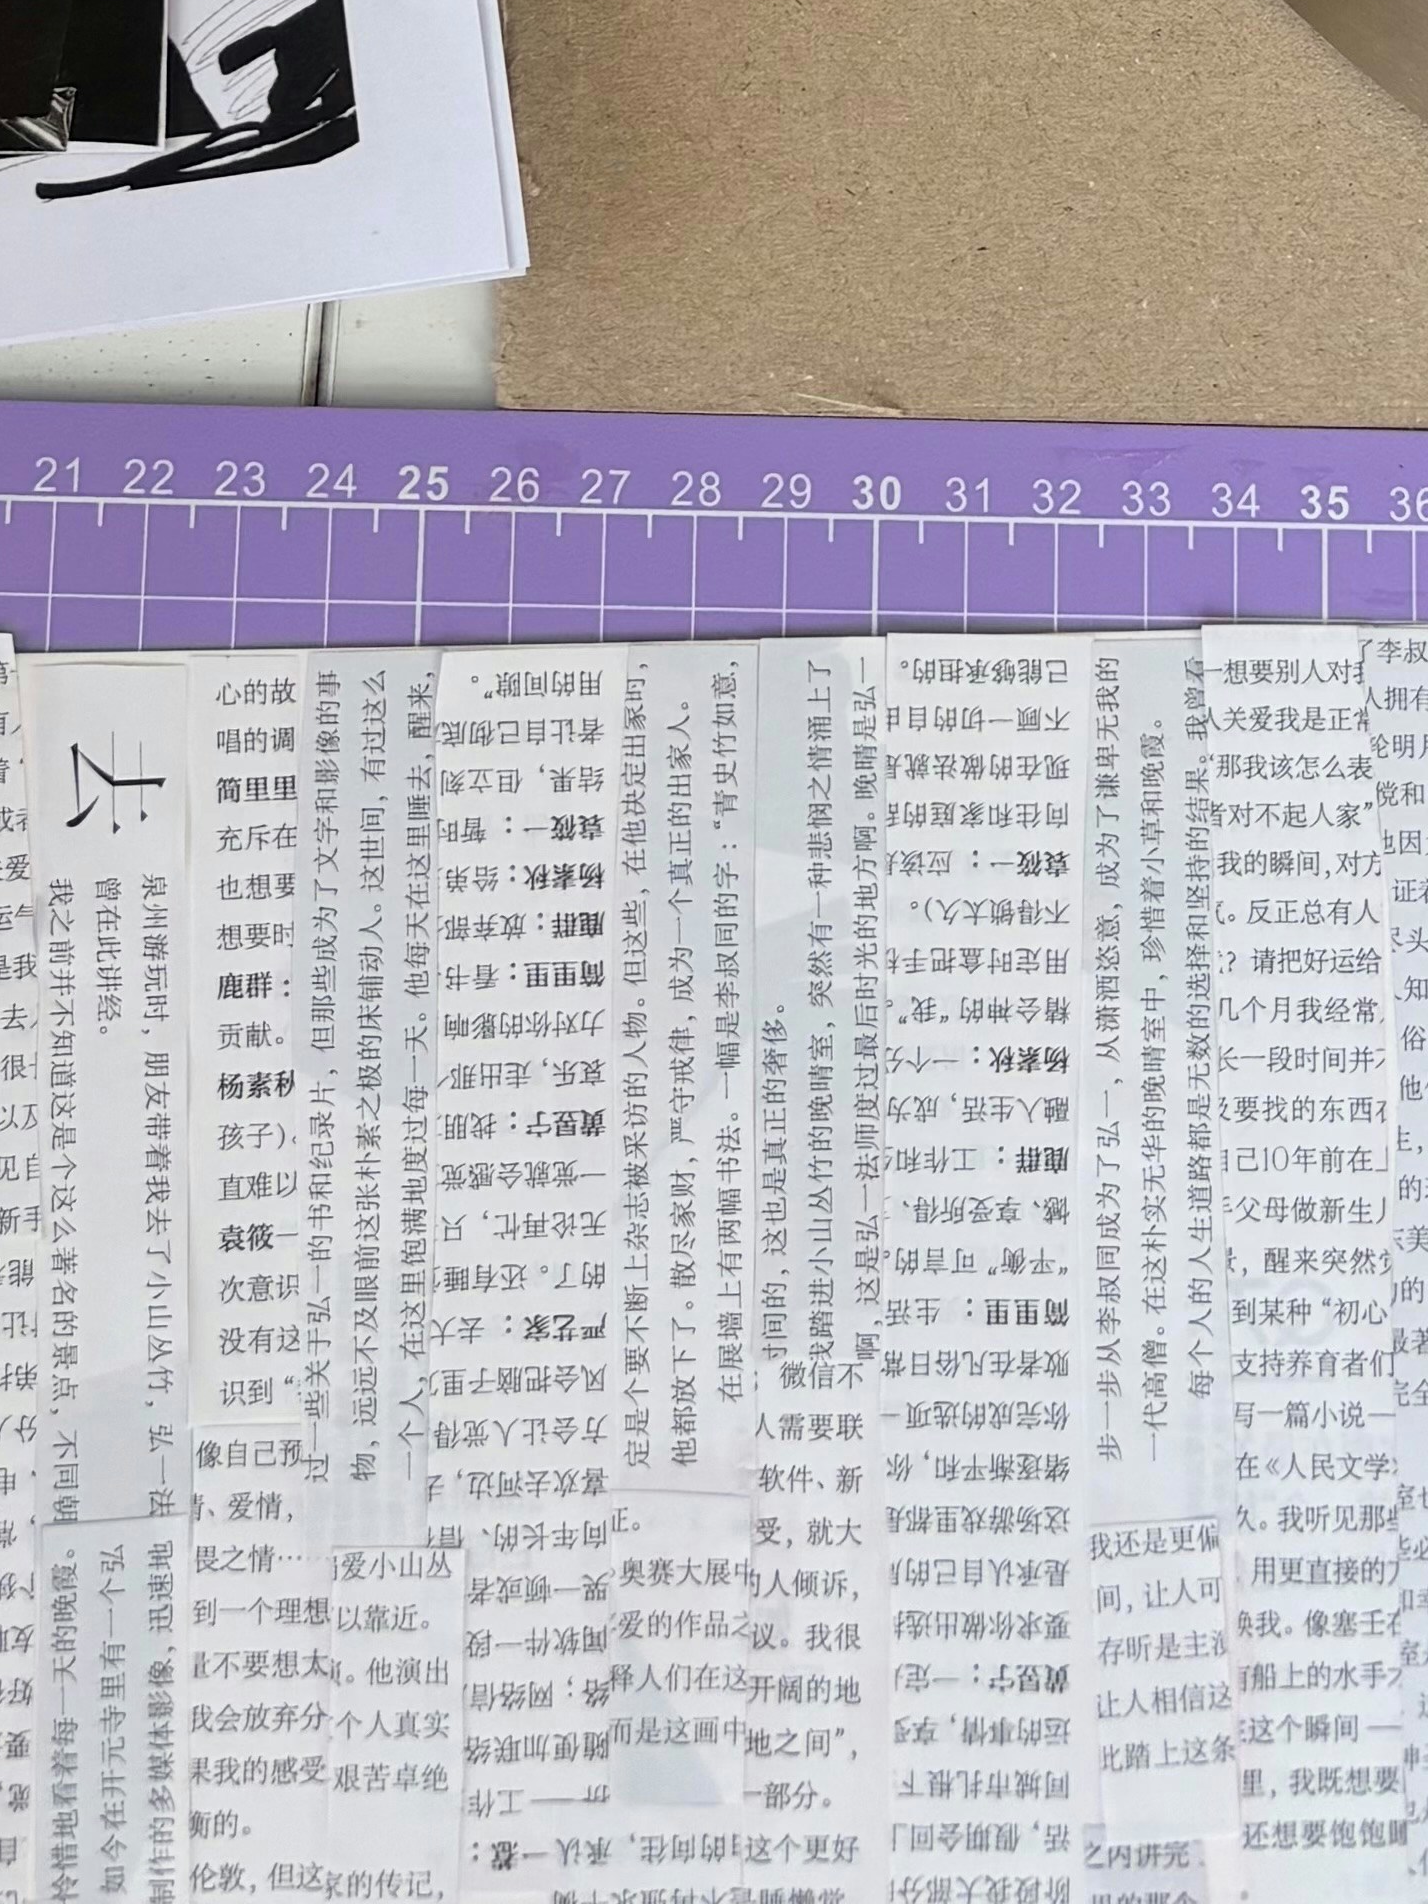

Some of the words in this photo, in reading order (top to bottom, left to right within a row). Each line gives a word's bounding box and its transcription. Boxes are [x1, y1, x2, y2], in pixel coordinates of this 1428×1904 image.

[32, 456, 80, 493] 21
[122, 458, 174, 496] 22
[213, 460, 266, 498] 23
[304, 462, 357, 499] 24
[395, 464, 450, 502] 25
[488, 466, 540, 504] 26
[579, 468, 631, 505] 27
[669, 470, 722, 508] 28
[760, 472, 812, 510] 29
[851, 474, 902, 512] 30
[945, 476, 989, 513] 31
[1032, 478, 1082, 516] 32
[1122, 480, 1171, 517] 33
[1211, 482, 1260, 519] 34
[1299, 484, 1351, 522] 35
[216, 677, 296, 706] 心的故
[216, 726, 295, 755] 唱的调
[66, 730, 167, 834] 去
[216, 824, 297, 853] 充斥在
[95, 877, 121, 1037] 曾在此讲经。
[217, 972, 290, 1001] 鹿群：
[218, 1020, 286, 1050] 贡献。
[444, 1009, 605, 1040] 力对你的影响
